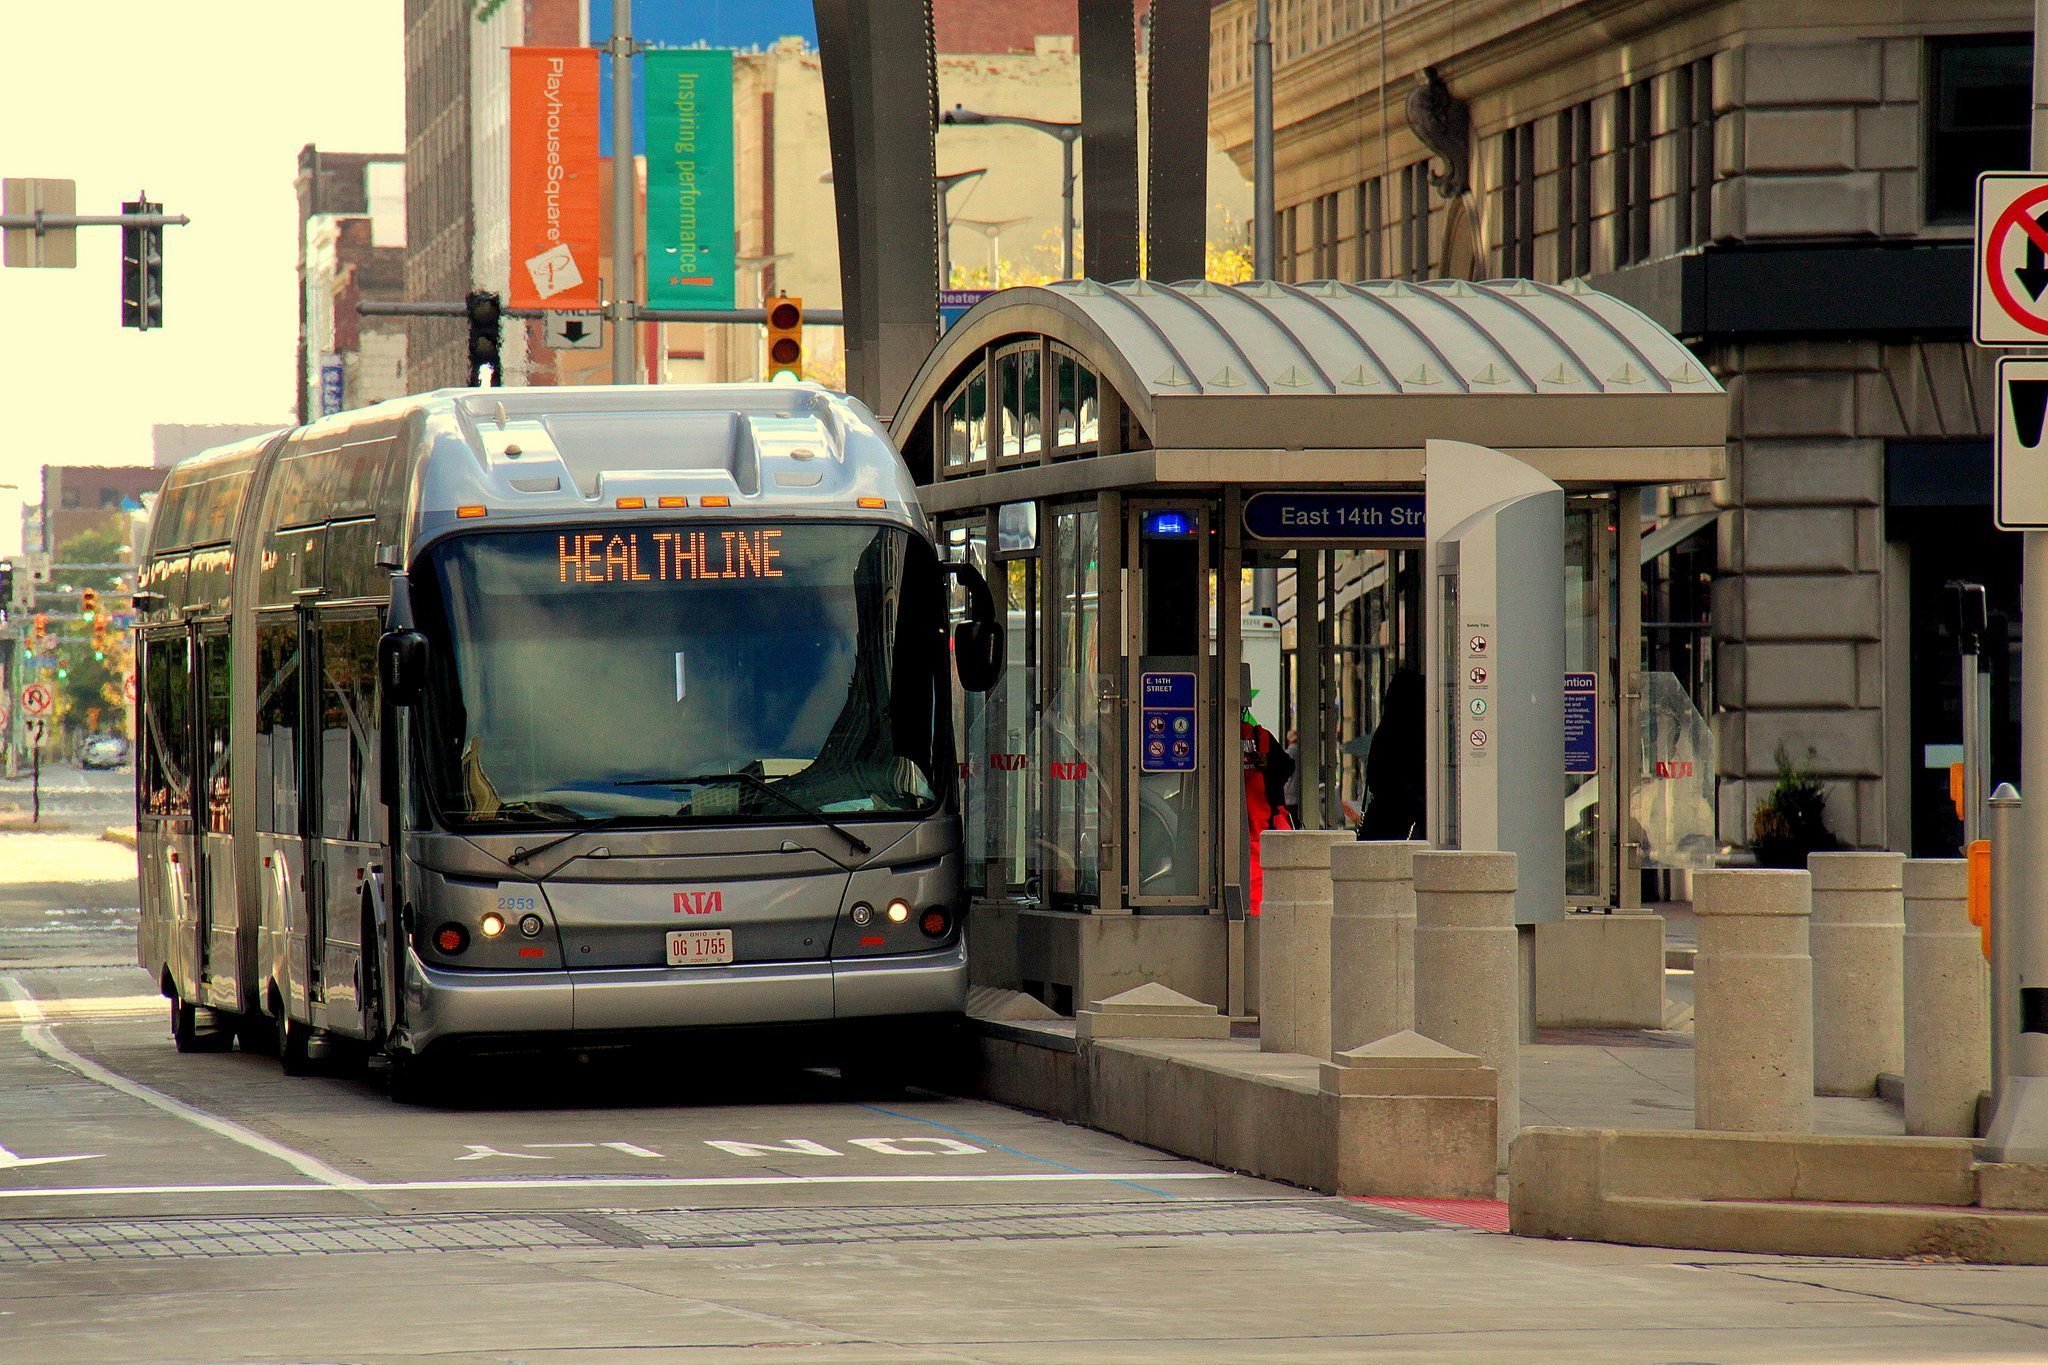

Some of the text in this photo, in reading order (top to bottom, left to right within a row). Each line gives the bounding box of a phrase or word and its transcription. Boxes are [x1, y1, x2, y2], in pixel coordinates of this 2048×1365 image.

[675, 73, 699, 153] Inspiring
[544, 57, 564, 241] PlayhouseSquare
[1281, 506, 1426, 525] East 14th Str
[558, 530, 783, 582] HEALTHLINE
[990, 753, 1026, 771] RTA
[1050, 762, 1088, 780] RTA
[497, 897, 535, 911] 2953
[673, 891, 722, 914] RTA
[695, 937, 726, 956] 1755
[454, 1137, 988, 1161] ONLY
